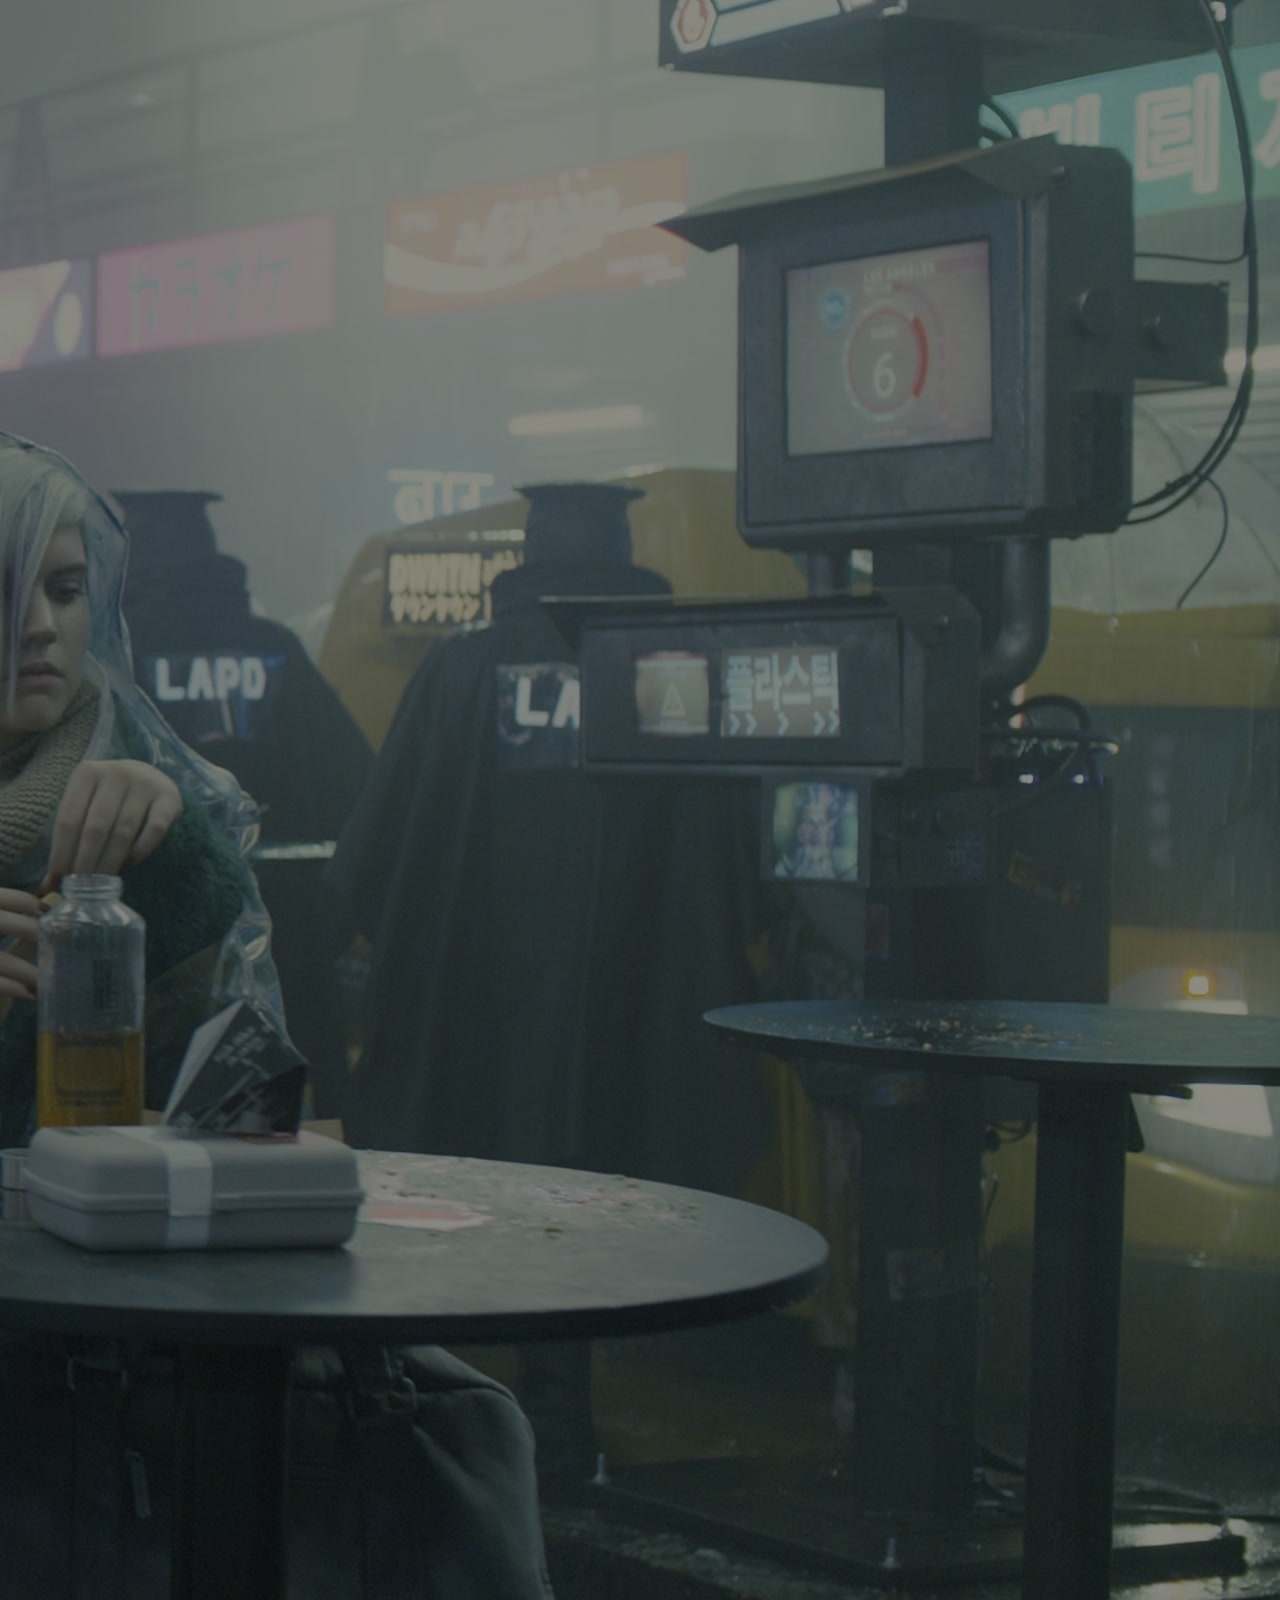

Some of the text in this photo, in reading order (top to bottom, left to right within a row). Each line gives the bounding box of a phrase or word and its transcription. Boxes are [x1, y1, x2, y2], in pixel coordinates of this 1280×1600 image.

[872, 351, 896, 399] 6
[155, 655, 267, 701] LAPD
[726, 650, 839, 712] 플라스틱
